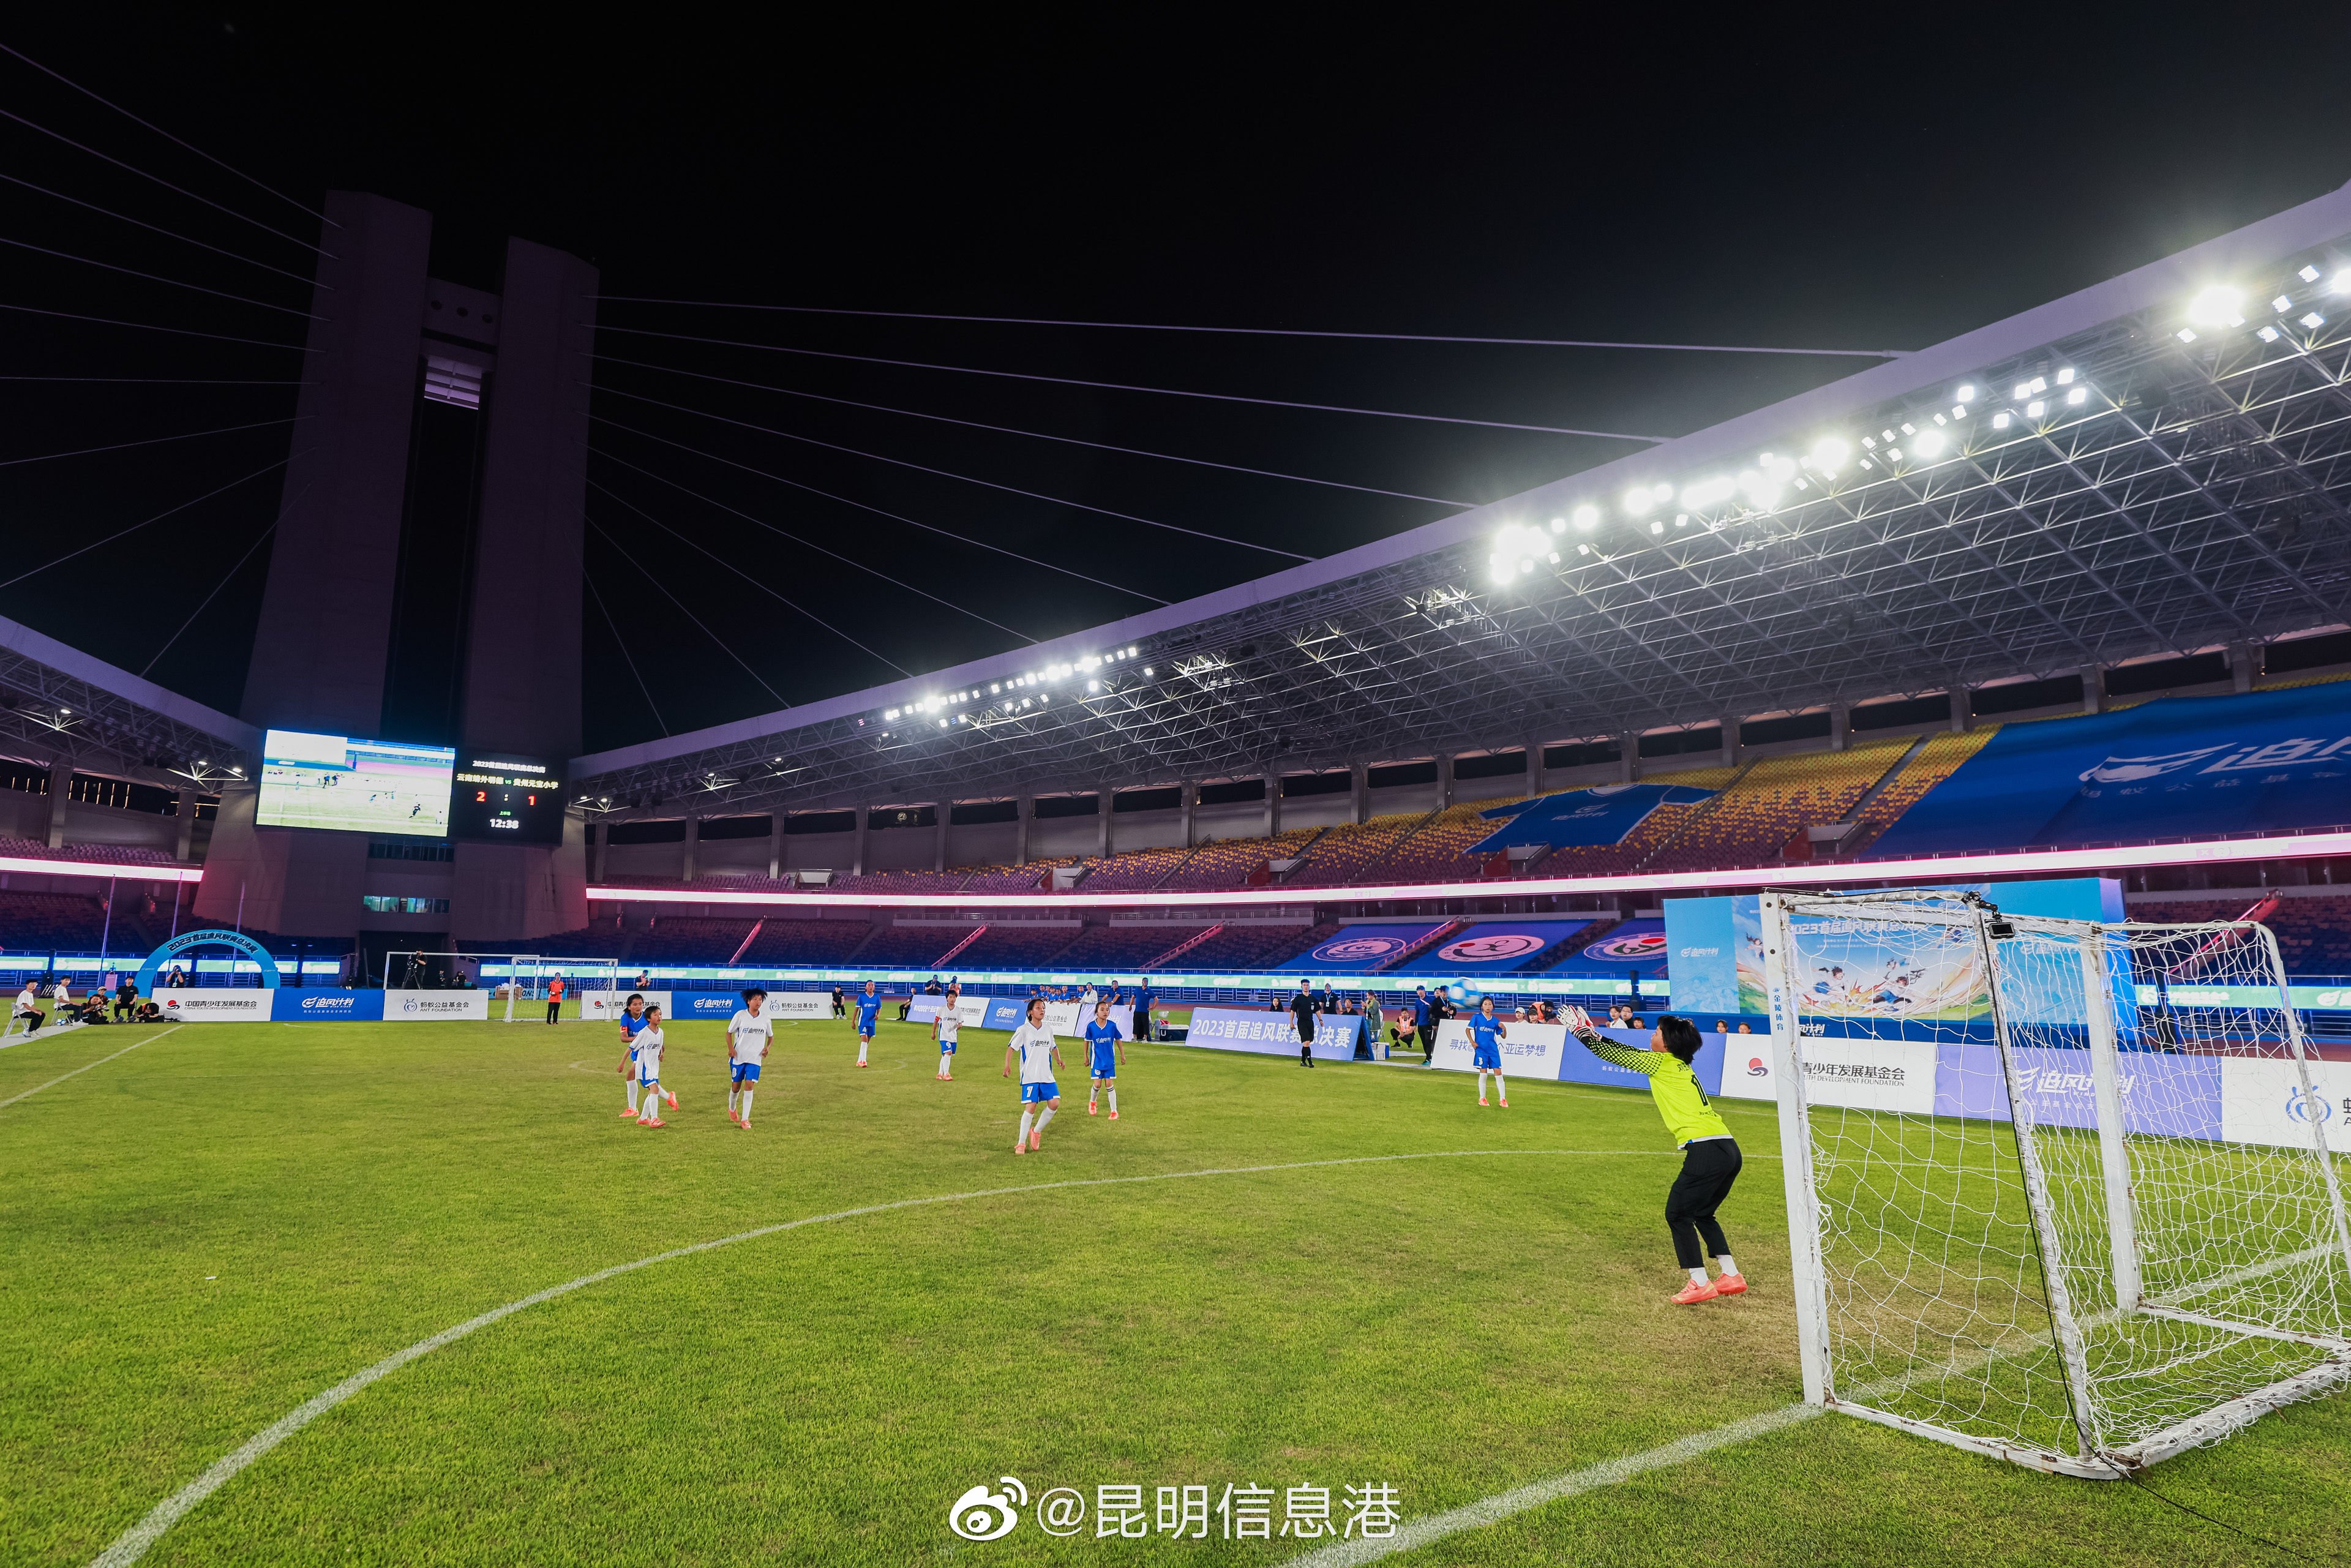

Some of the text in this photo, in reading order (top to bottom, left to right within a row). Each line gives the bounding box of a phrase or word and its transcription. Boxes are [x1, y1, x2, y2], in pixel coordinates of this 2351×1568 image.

[476, 790, 486, 802] 2
[528, 796, 536, 806] 1
[490, 819, 519, 829] 12:38
[167, 932, 259, 954] 2023首届追风联赛总决赛
[315, 997, 354, 1008] 追风计划
[704, 999, 733, 1008] 追风计划
[1774, 995, 1784, 1030] 金陵体育
[1799, 1023, 1826, 1034] 风计划
[1802, 1062, 1905, 1081] 青少年发展基金会
[1817, 1075, 1859, 1084] DEVELOPMENT
[2036, 1070, 2135, 1095] 追风划
